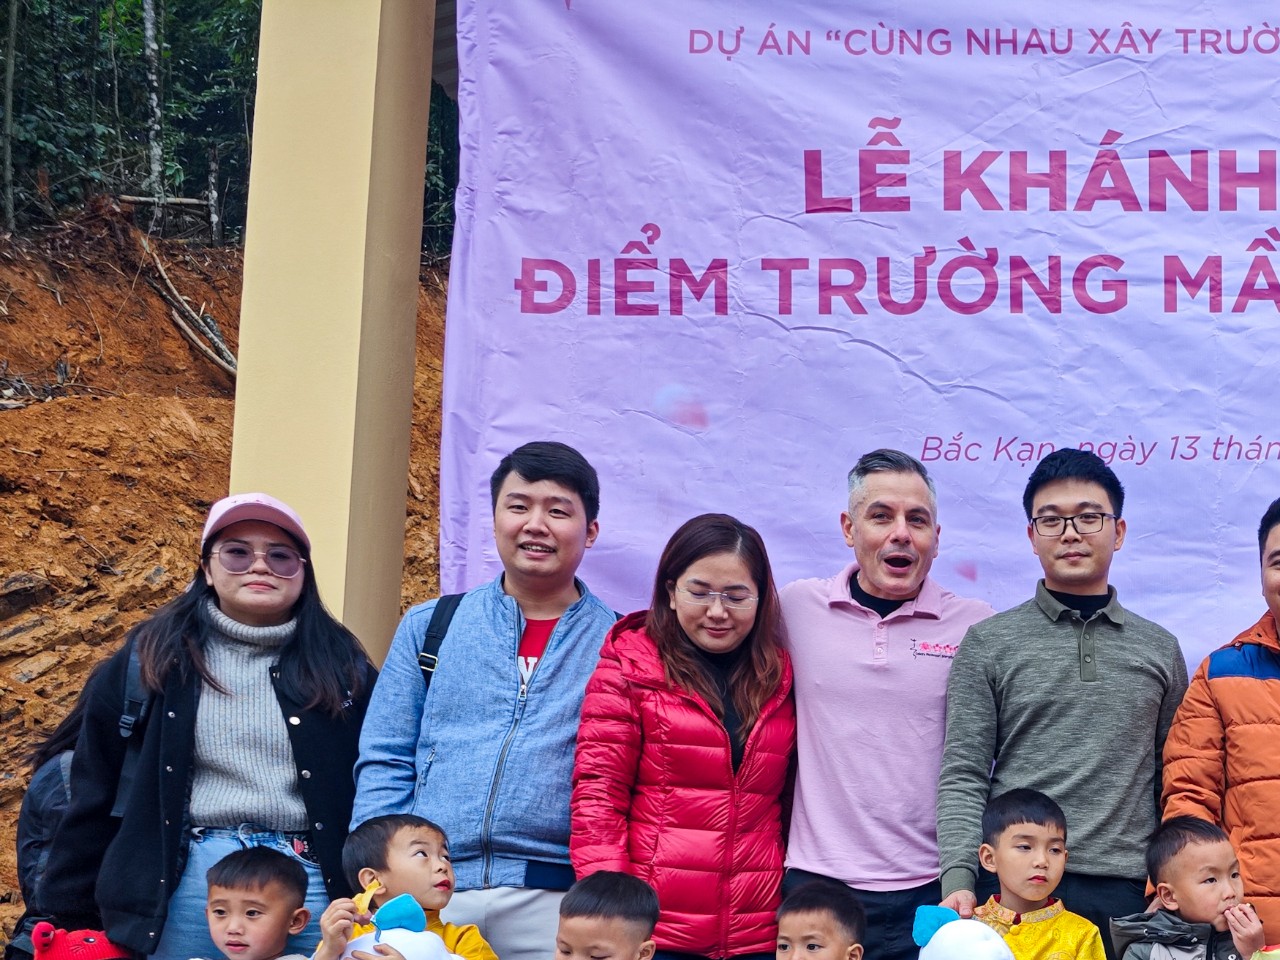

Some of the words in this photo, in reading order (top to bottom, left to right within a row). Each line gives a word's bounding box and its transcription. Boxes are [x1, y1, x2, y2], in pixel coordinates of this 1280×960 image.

[690, 26, 744, 61] DỰ
[759, 24, 811, 56] ÁN
[968, 28, 1074, 56] NHAU
[1088, 23, 1160, 55] XÂY
[803, 117, 911, 214] LỄ
[943, 129, 1277, 213] KHÁNH
[514, 223, 729, 316] ĐIỂM
[761, 236, 1129, 315] TRƯỜNG
[921, 432, 982, 462] Bắc
[1172, 436, 1201, 462] 13
